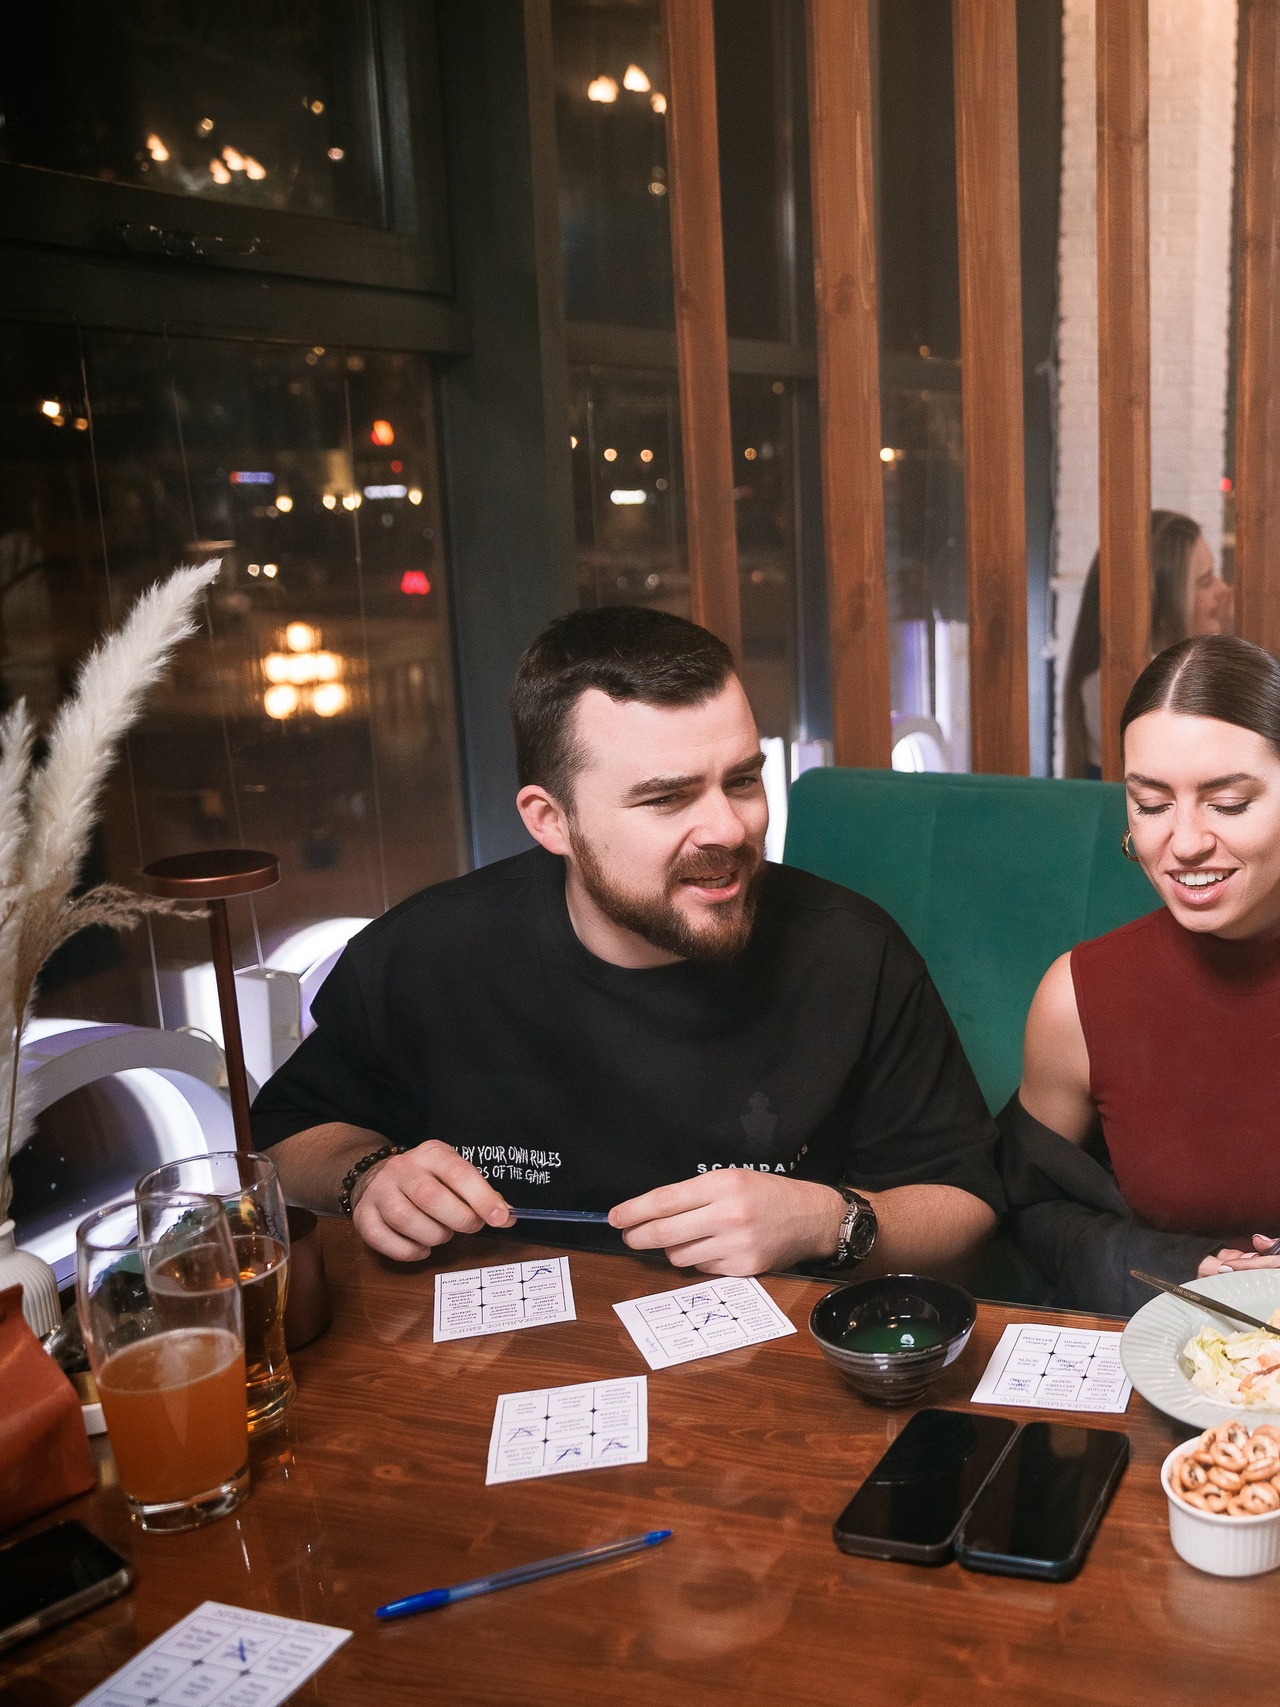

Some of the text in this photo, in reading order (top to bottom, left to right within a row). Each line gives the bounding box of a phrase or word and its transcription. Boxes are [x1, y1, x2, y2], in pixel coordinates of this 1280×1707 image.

[462, 1146, 475, 1164] BY
[477, 1146, 507, 1165] YOUR
[508, 1146, 529, 1164] OWN
[530, 1149, 562, 1169] RULES
[492, 1165, 506, 1180] OF
[507, 1165, 523, 1180] THE
[524, 1168, 551, 1185] GAME
[486, 1314, 556, 1328] МУЗЫКАЛЬНОЕ
[450, 1326, 481, 1334] БИНГО
[1034, 1400, 1106, 1410] МУЗЫКАЛЬНОЕ
